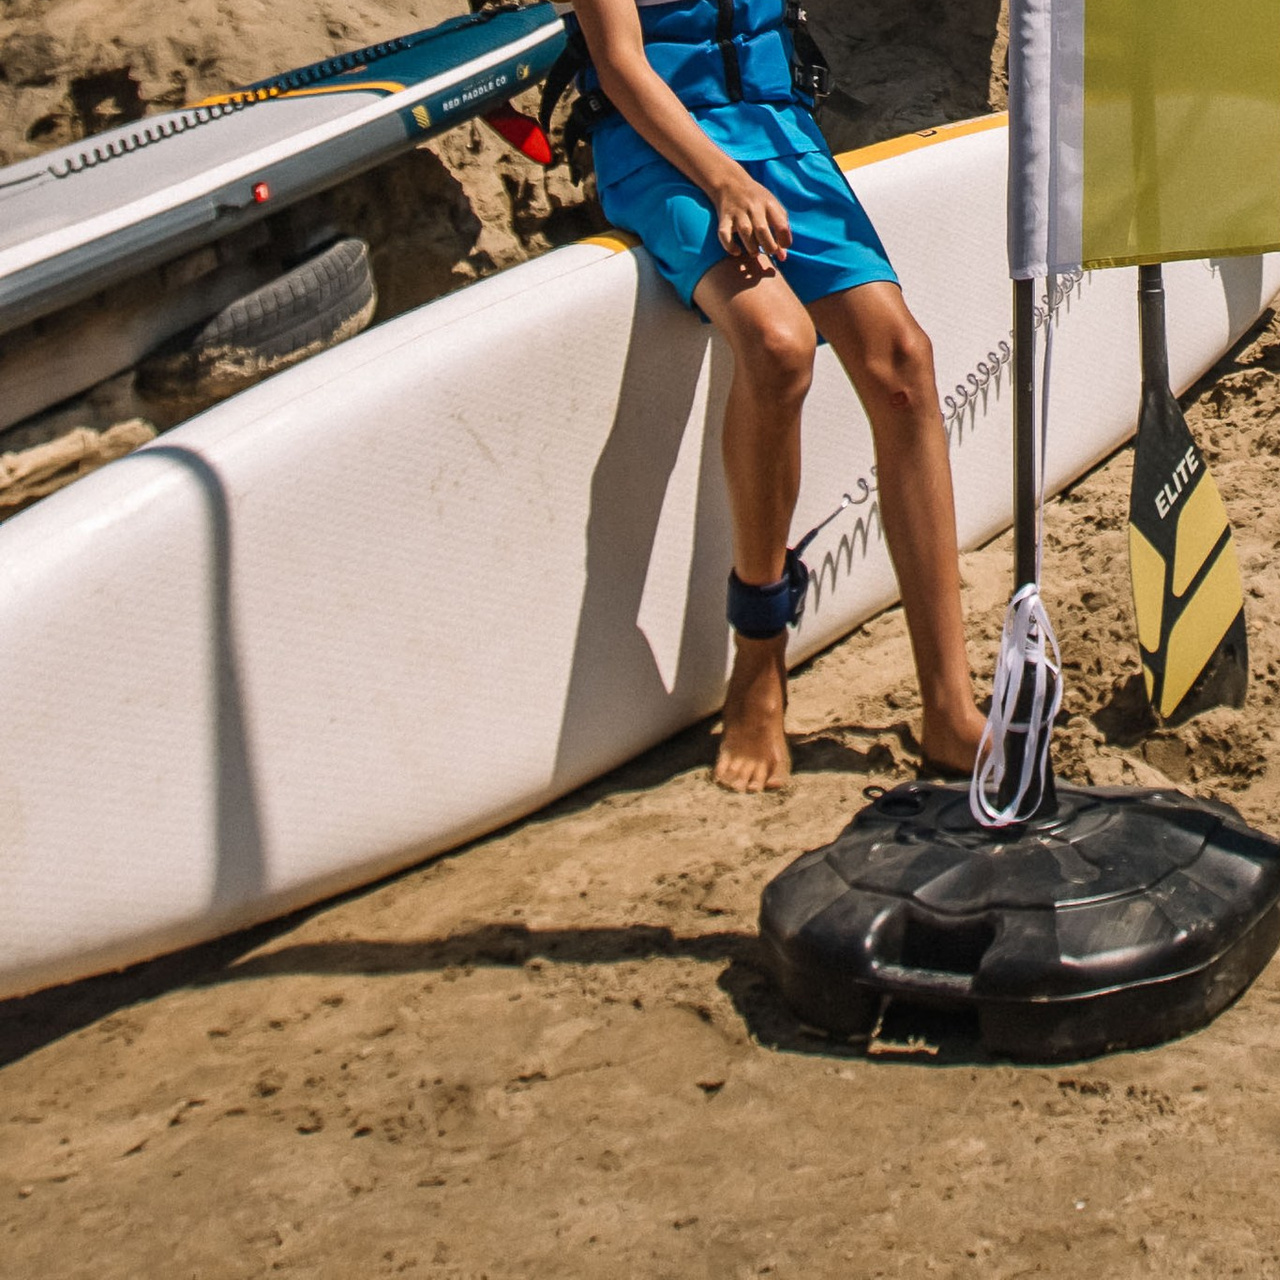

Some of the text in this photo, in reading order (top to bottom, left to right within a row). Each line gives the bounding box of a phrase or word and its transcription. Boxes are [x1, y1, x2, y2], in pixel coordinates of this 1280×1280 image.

[442, 97, 460, 111] RED
[462, 82, 494, 102] PADDLE
[496, 75, 507, 87] CO
[1155, 445, 1199, 519] ELITE
